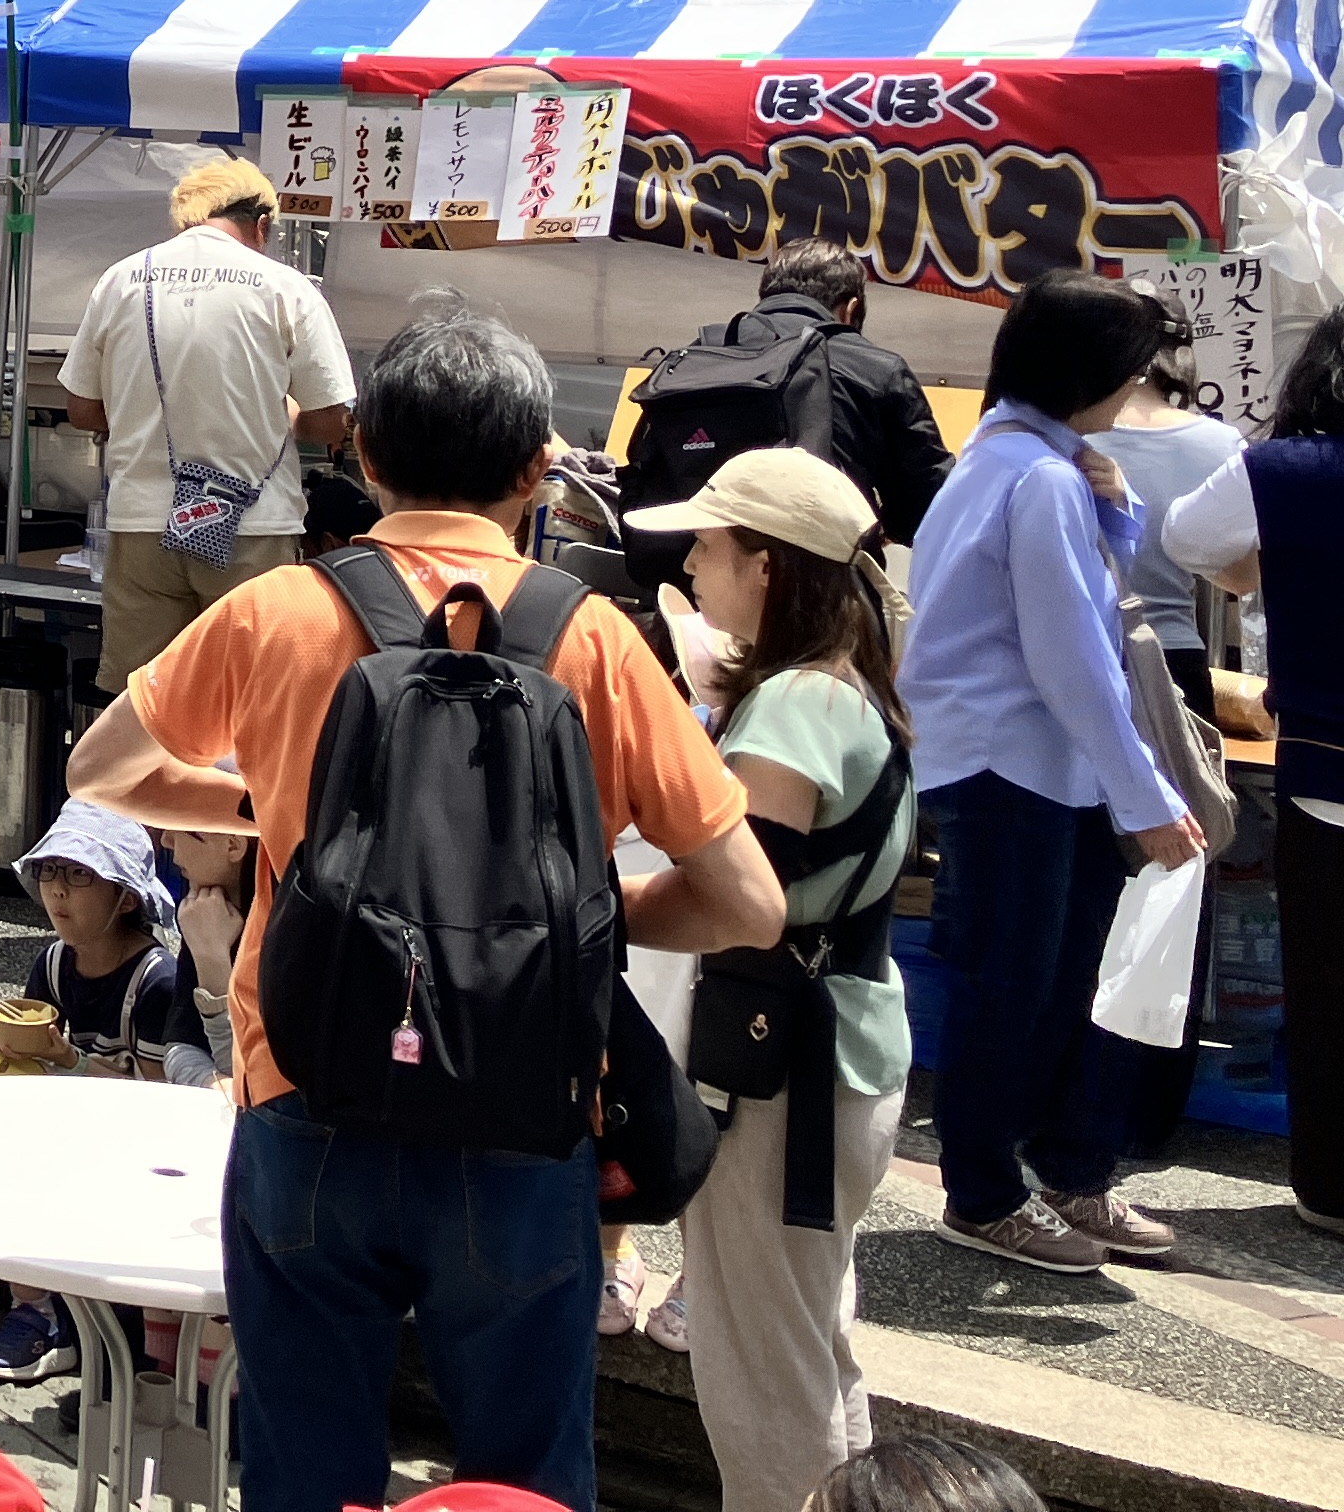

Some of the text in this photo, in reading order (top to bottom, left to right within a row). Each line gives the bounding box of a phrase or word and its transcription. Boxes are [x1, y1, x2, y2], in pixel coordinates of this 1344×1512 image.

[759, 76, 995, 128] ほくほく
[284, 100, 313, 188] 生ビール
[352, 124, 370, 199] ウーロンハイ
[384, 126, 405, 190] 緑茶ハイ
[447, 100, 472, 199] レモンサワー
[572, 93, 616, 212] 角ハイボール
[288, 196, 320, 212] 500
[534, 216, 601, 235] 500円
[615, 139, 1199, 291] じゃがバター
[214, 267, 264, 287] MUSIC
[1220, 257, 1270, 423] 明太マヨネーズ
[683, 441, 716, 451] adidas
[553, 507, 600, 530] COSTCO
[438, 566, 490, 582] YONEX
